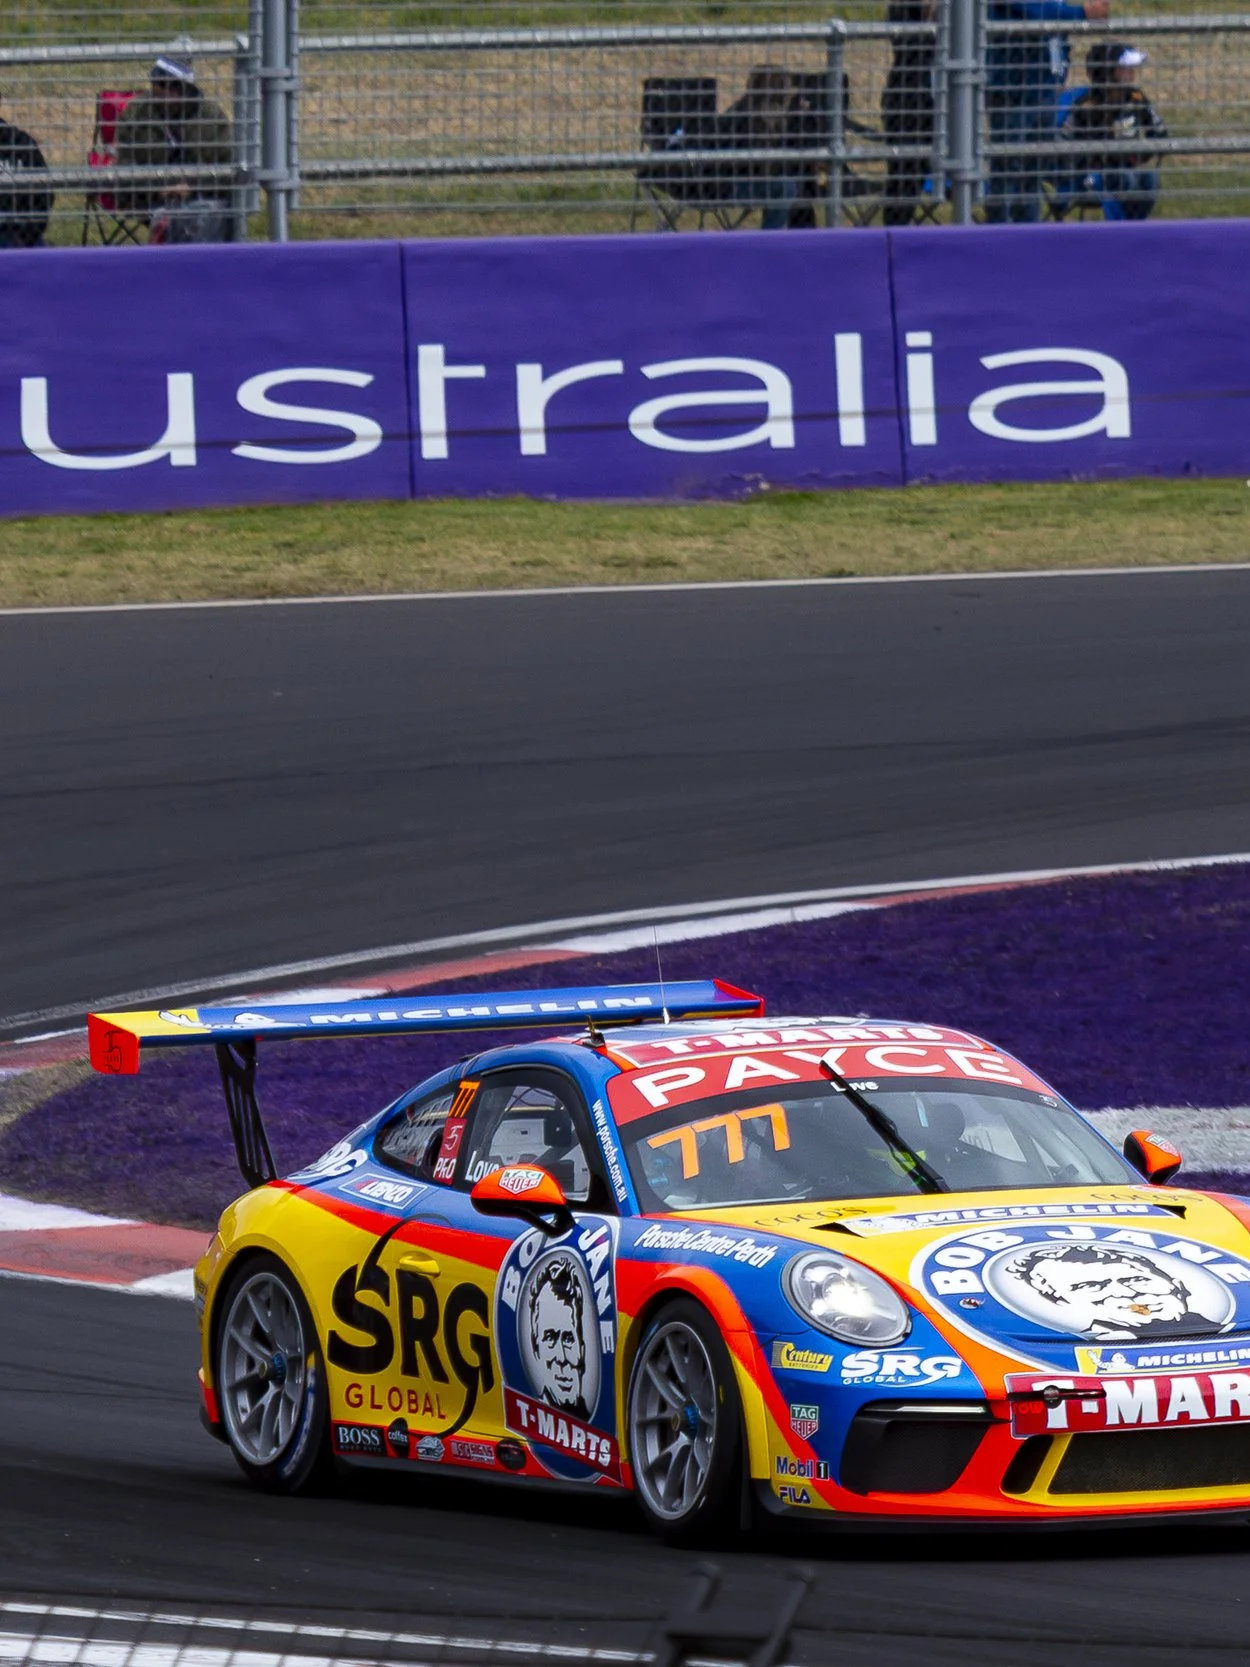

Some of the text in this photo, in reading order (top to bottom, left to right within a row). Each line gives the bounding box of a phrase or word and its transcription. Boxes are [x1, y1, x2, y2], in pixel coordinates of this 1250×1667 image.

[20, 331, 1131, 471] ustralia
[307, 996, 653, 1024] MICHELIN
[651, 1027, 944, 1054] T-MARTS
[631, 1046, 1022, 1108] PAYCE
[592, 1099, 628, 1203] www.porsche.com.au
[646, 1104, 791, 1180] 777
[433, 1157, 457, 1179] PRO
[922, 1203, 1149, 1223] MICHELIN
[634, 1224, 779, 1268] Porsche Centre Perth
[932, 1231, 1025, 1296] BOB
[578, 1224, 615, 1354] JANE
[326, 1252, 495, 1400] SRG
[841, 1349, 962, 1384] SRG
[843, 1375, 906, 1385] GLOBAL
[345, 1382, 447, 1420] GLOBAL
[793, 1407, 816, 1419] TAG
[338, 1426, 380, 1446] BOSS
[516, 1400, 611, 1465] T-MARTS
[791, 1420, 816, 1438] HEUER
[776, 1455, 814, 1479] Mobil
[779, 1485, 812, 1505] FILA
